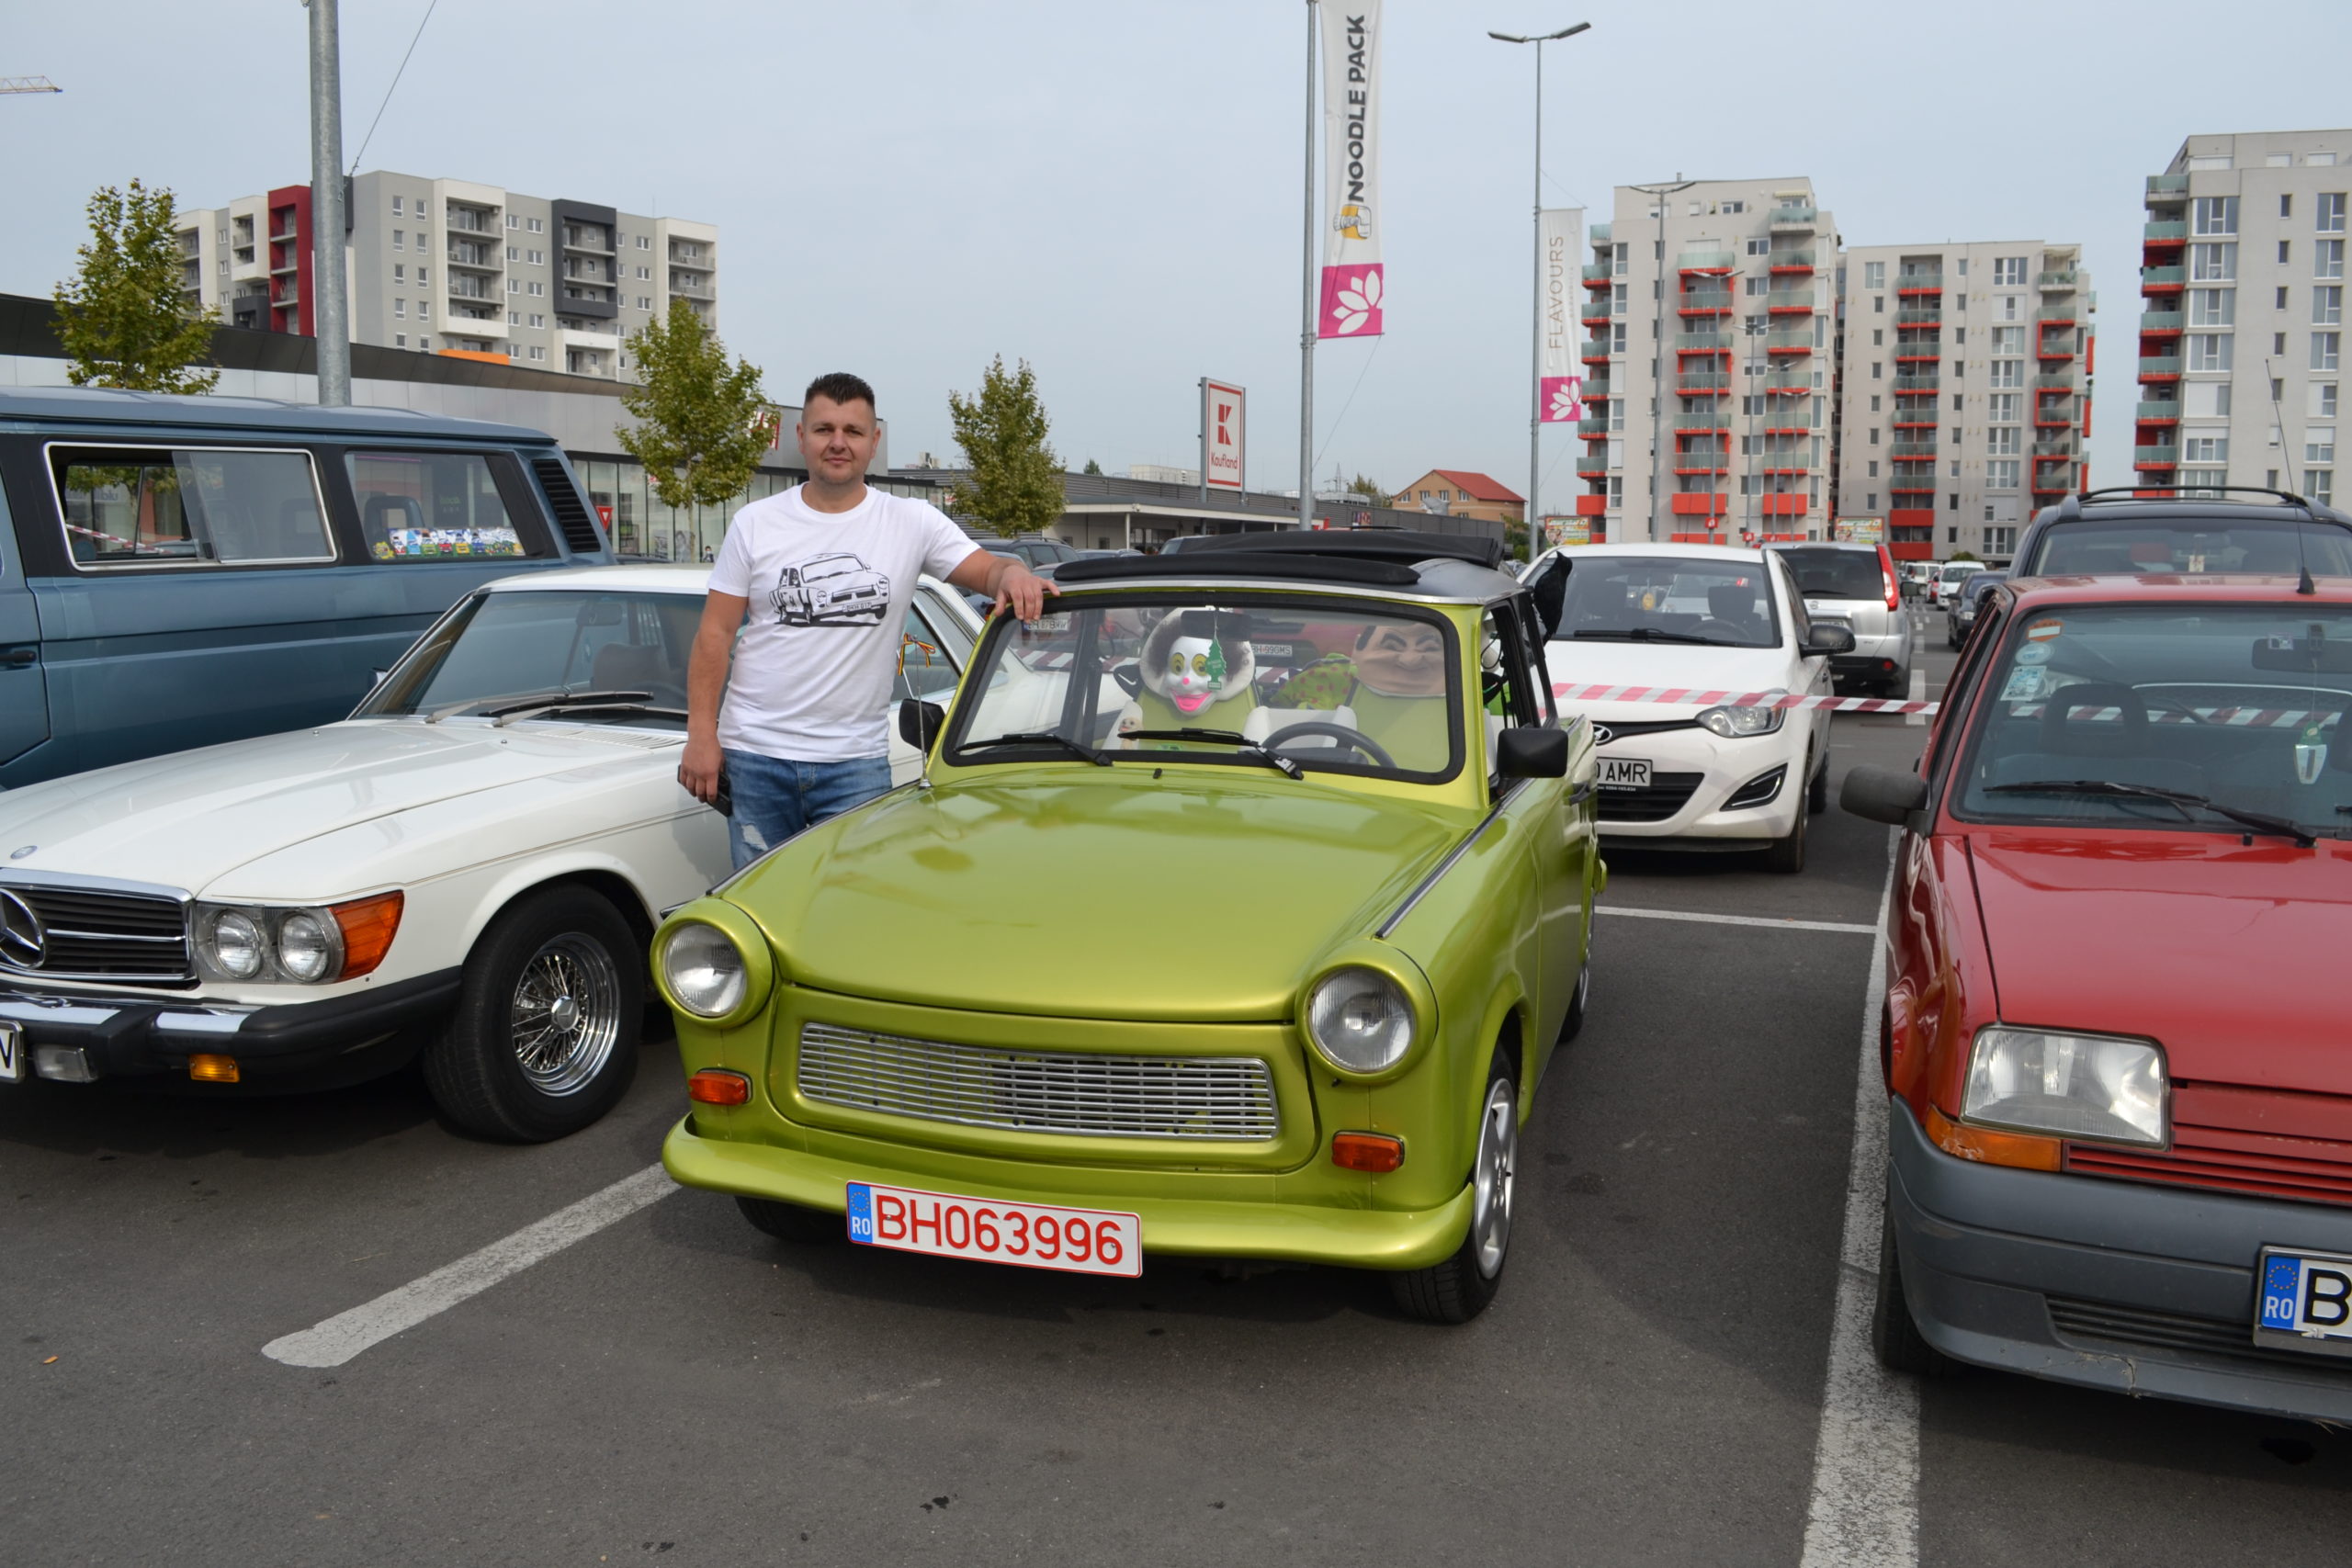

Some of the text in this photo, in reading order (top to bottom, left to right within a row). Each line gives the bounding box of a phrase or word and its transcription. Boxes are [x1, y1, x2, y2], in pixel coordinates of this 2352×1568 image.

[1346, 15, 1366, 202] NOODLE PACK
[1549, 236, 1564, 349] FLAVOURS
[1211, 452, 1238, 469] Kaufland
[1605, 761, 1646, 783] AMR
[852, 1215, 871, 1236] RO
[876, 1194, 1123, 1266] BH063996
[2264, 1296, 2294, 1320] RO
[2302, 1268, 2352, 1326] B
